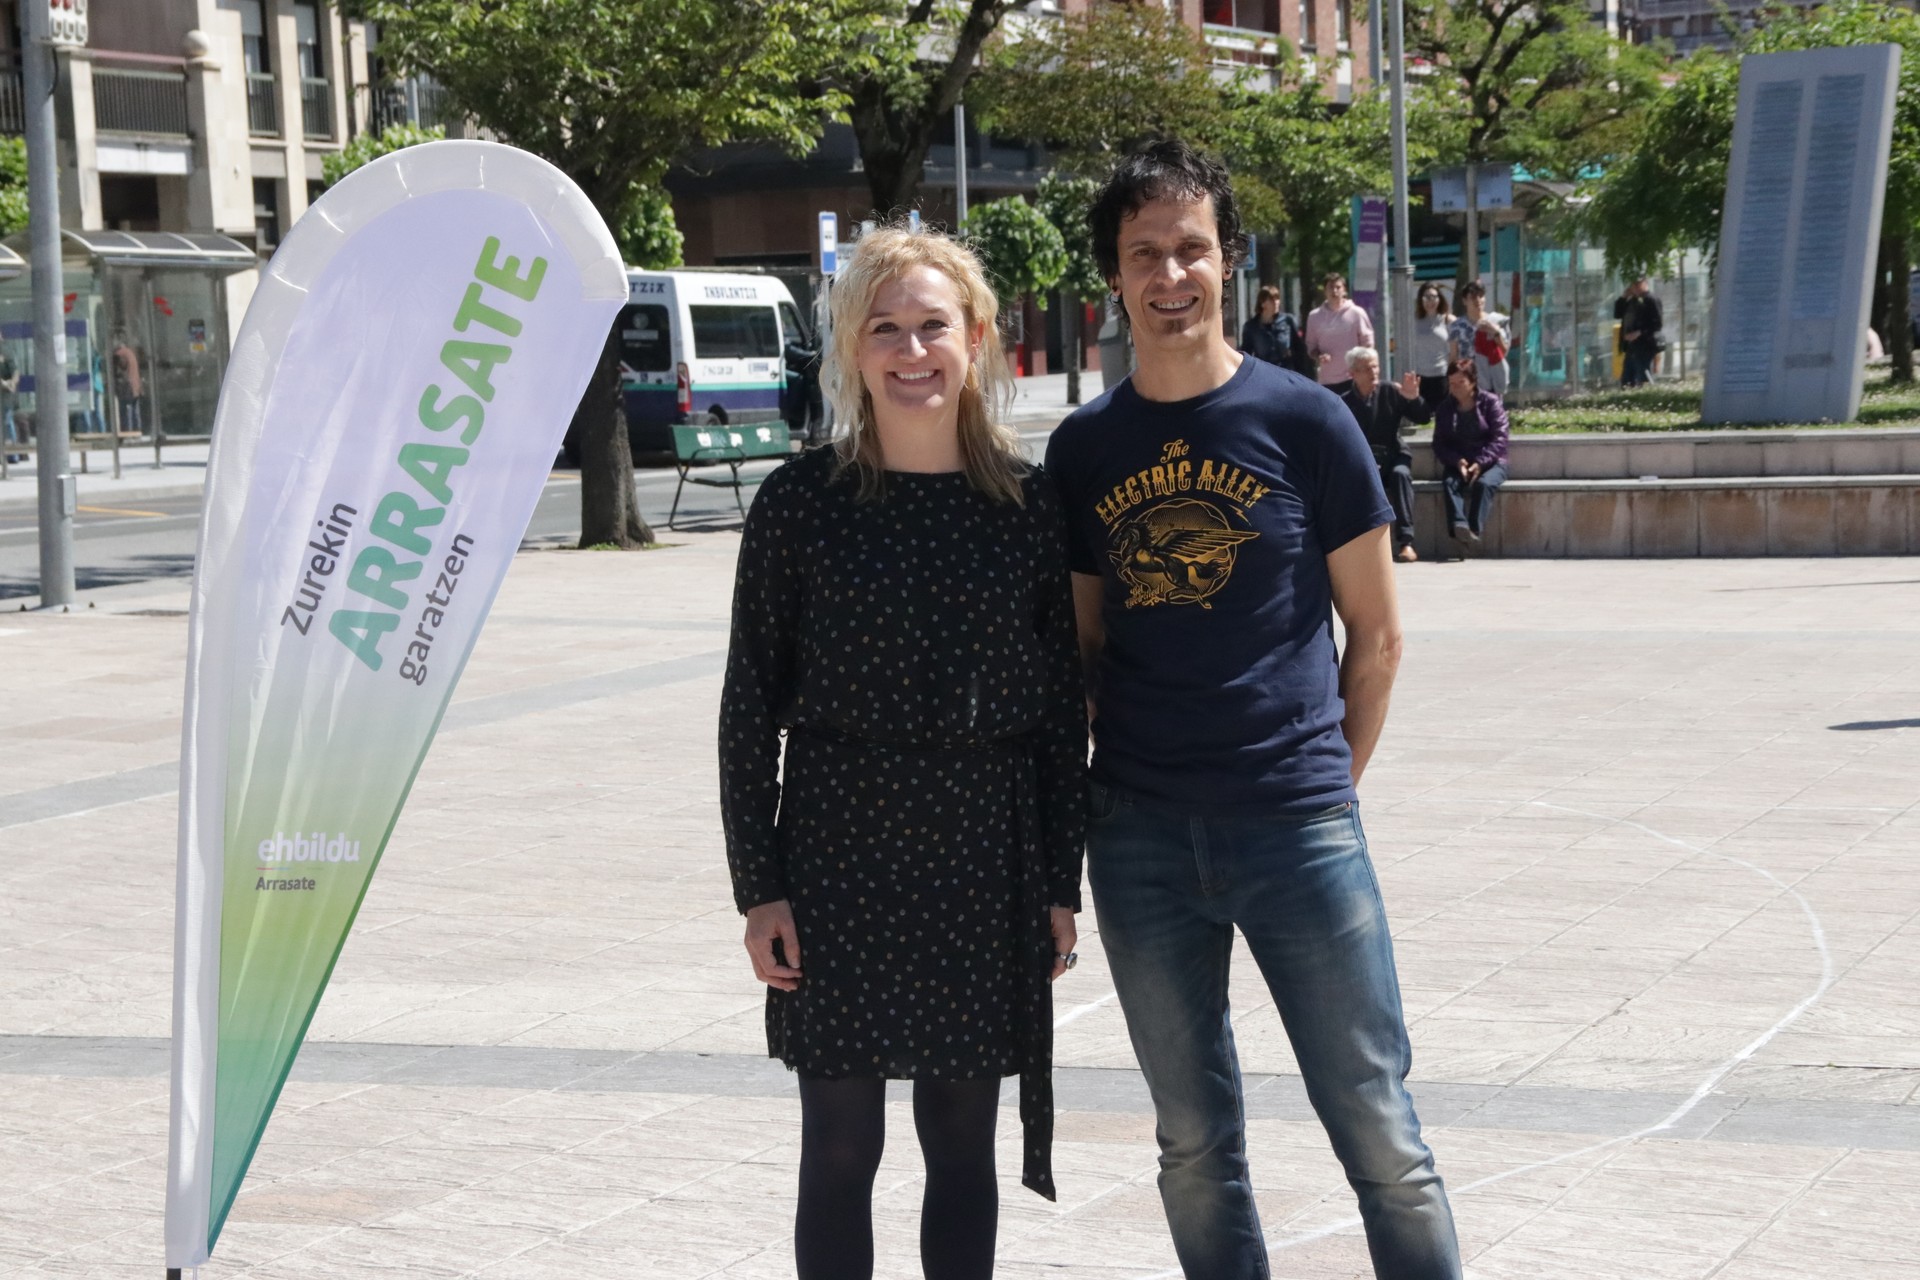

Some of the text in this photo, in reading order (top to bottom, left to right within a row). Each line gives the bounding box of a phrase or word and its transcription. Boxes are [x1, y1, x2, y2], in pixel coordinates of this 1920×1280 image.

[329, 236, 548, 672] ARRASATE
[1160, 438, 1190, 463] The
[1094, 459, 1272, 525] ELECTRIC ALLEY
[281, 502, 358, 636] Zurekin
[399, 532, 475, 686] garatzen
[257, 832, 361, 863] ehbildu
[255, 876, 317, 891] Arrasate
